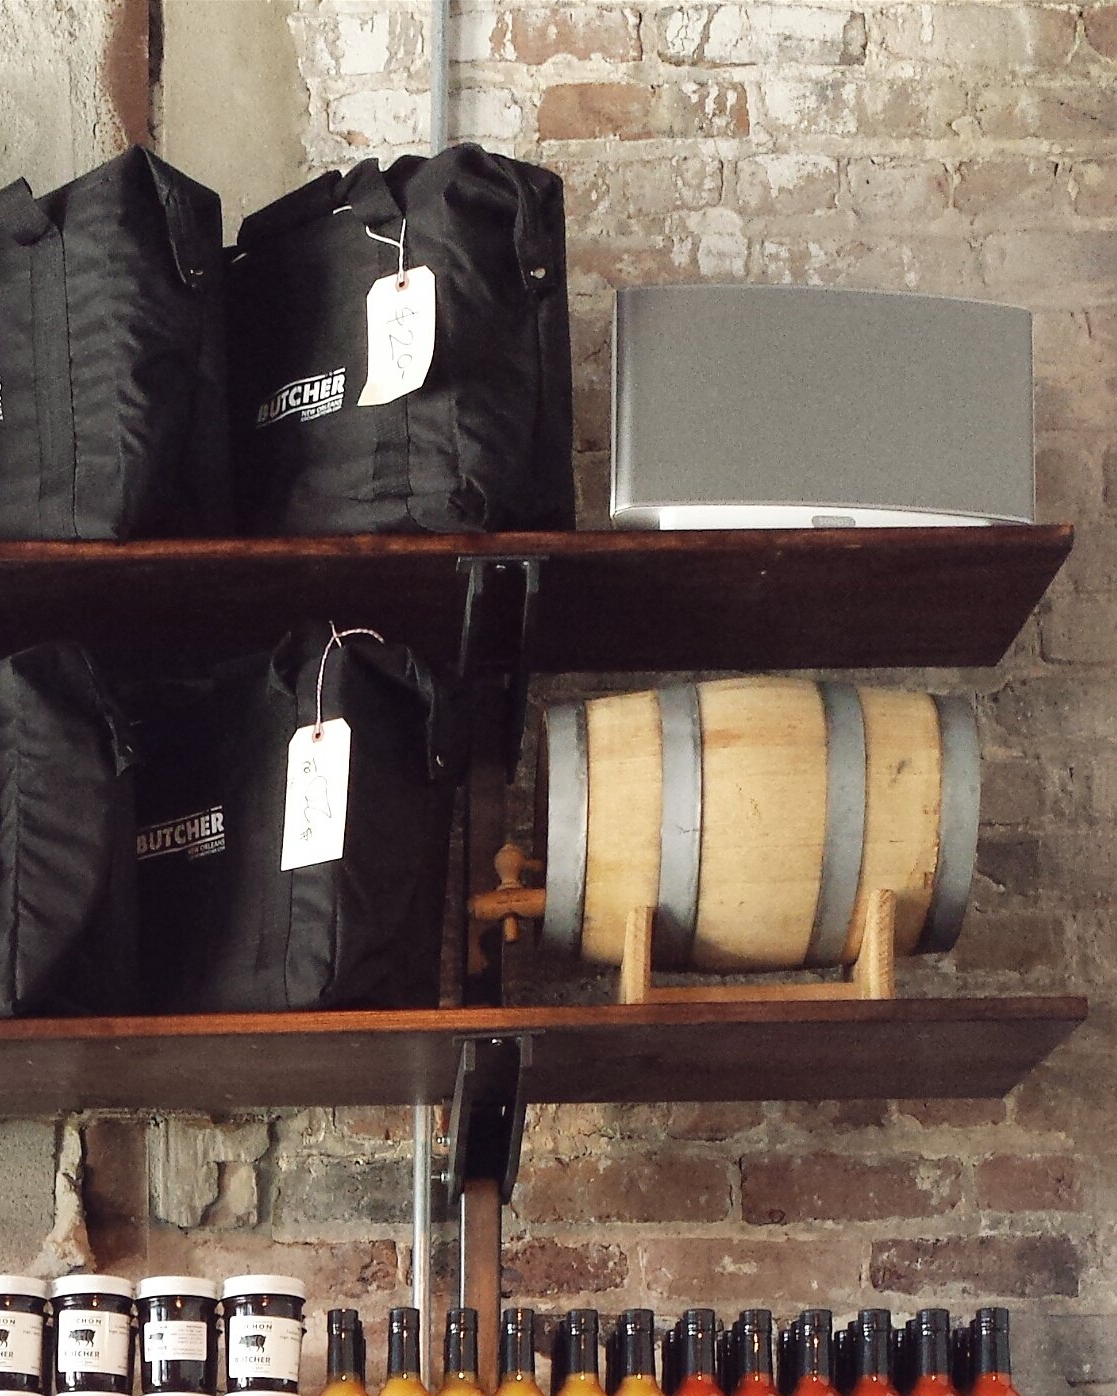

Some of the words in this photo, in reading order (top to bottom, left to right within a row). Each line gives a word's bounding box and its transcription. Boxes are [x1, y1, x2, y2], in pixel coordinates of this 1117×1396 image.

[258, 373, 346, 423] BUTCHER
[137, 812, 225, 853] BUTCHER
[64, 1350, 100, 1359] BTCHER
